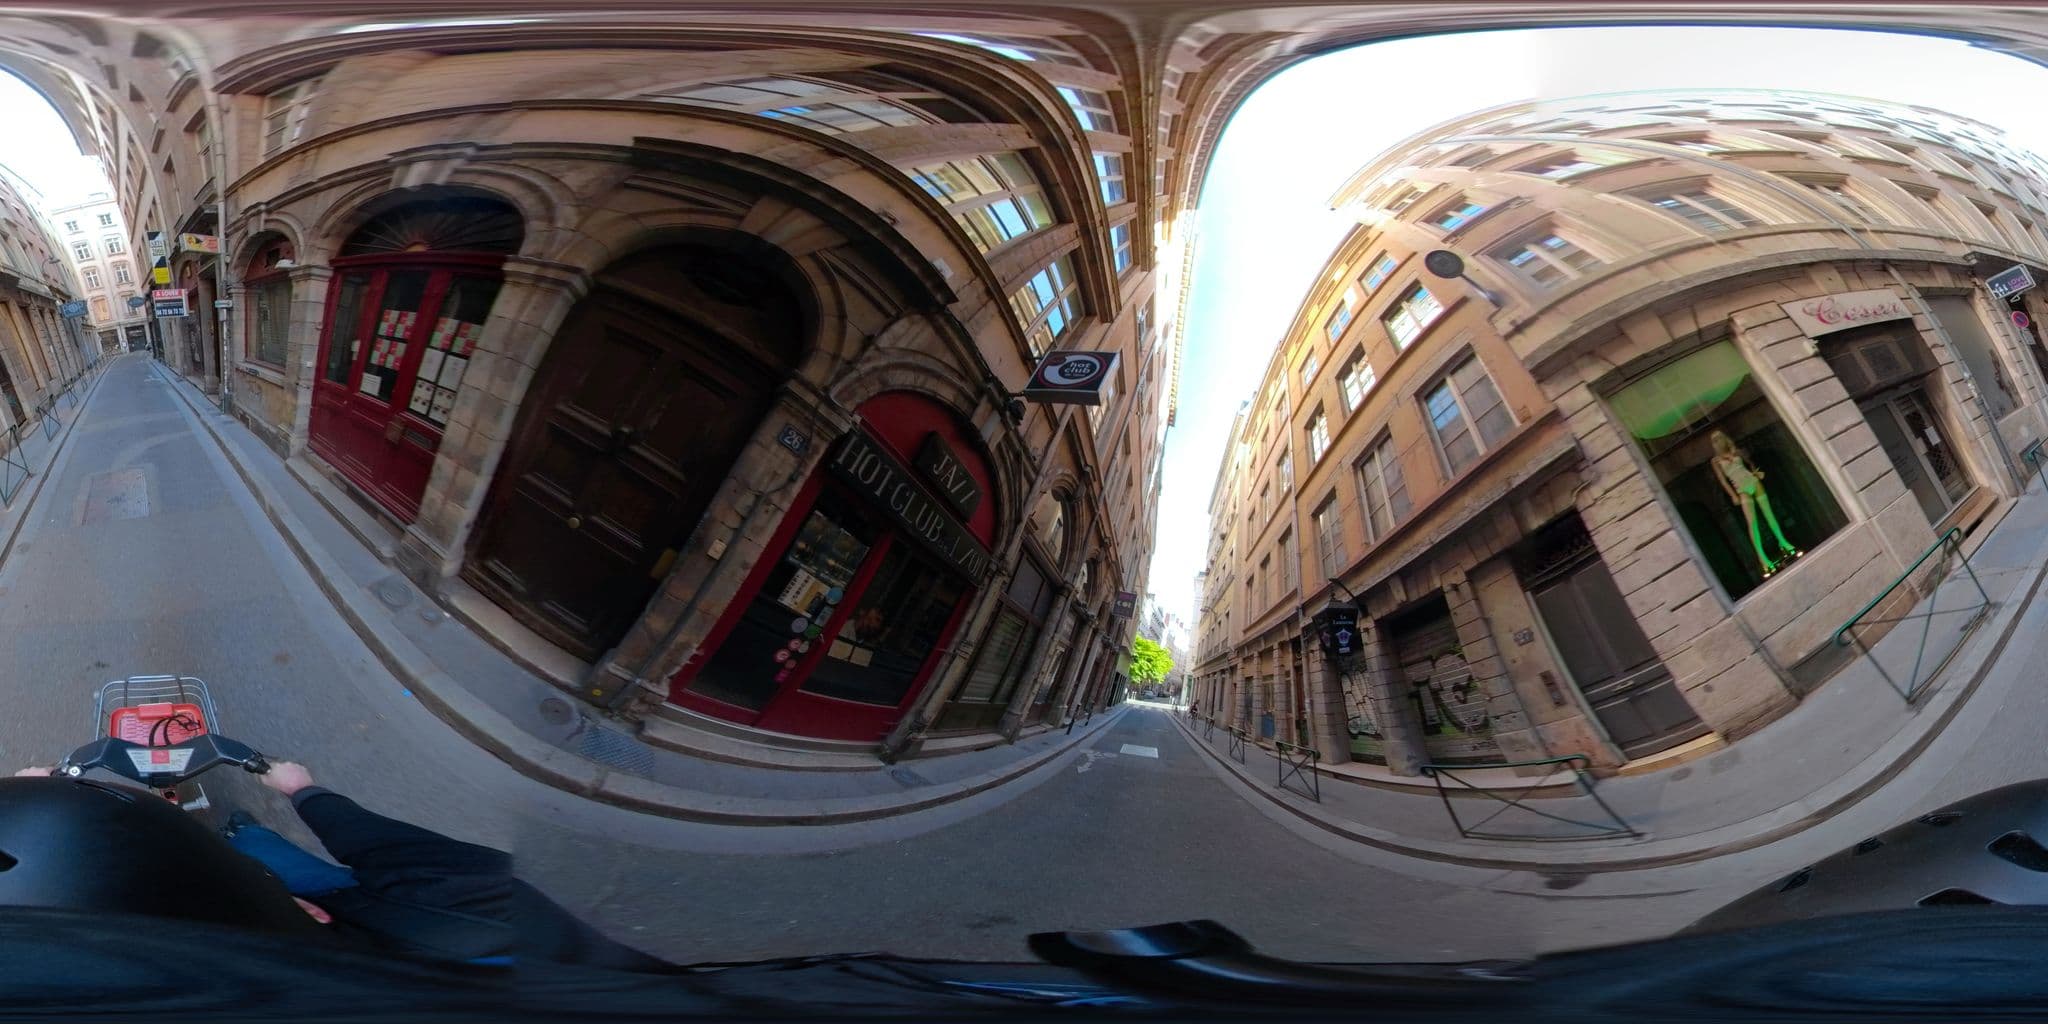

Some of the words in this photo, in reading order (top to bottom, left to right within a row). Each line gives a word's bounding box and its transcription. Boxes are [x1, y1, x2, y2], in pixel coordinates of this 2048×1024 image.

[1064, 366, 1091, 374] club
[784, 430, 804, 449] 26
[837, 435, 894, 498] HOT
[889, 482, 945, 542] CLUB
